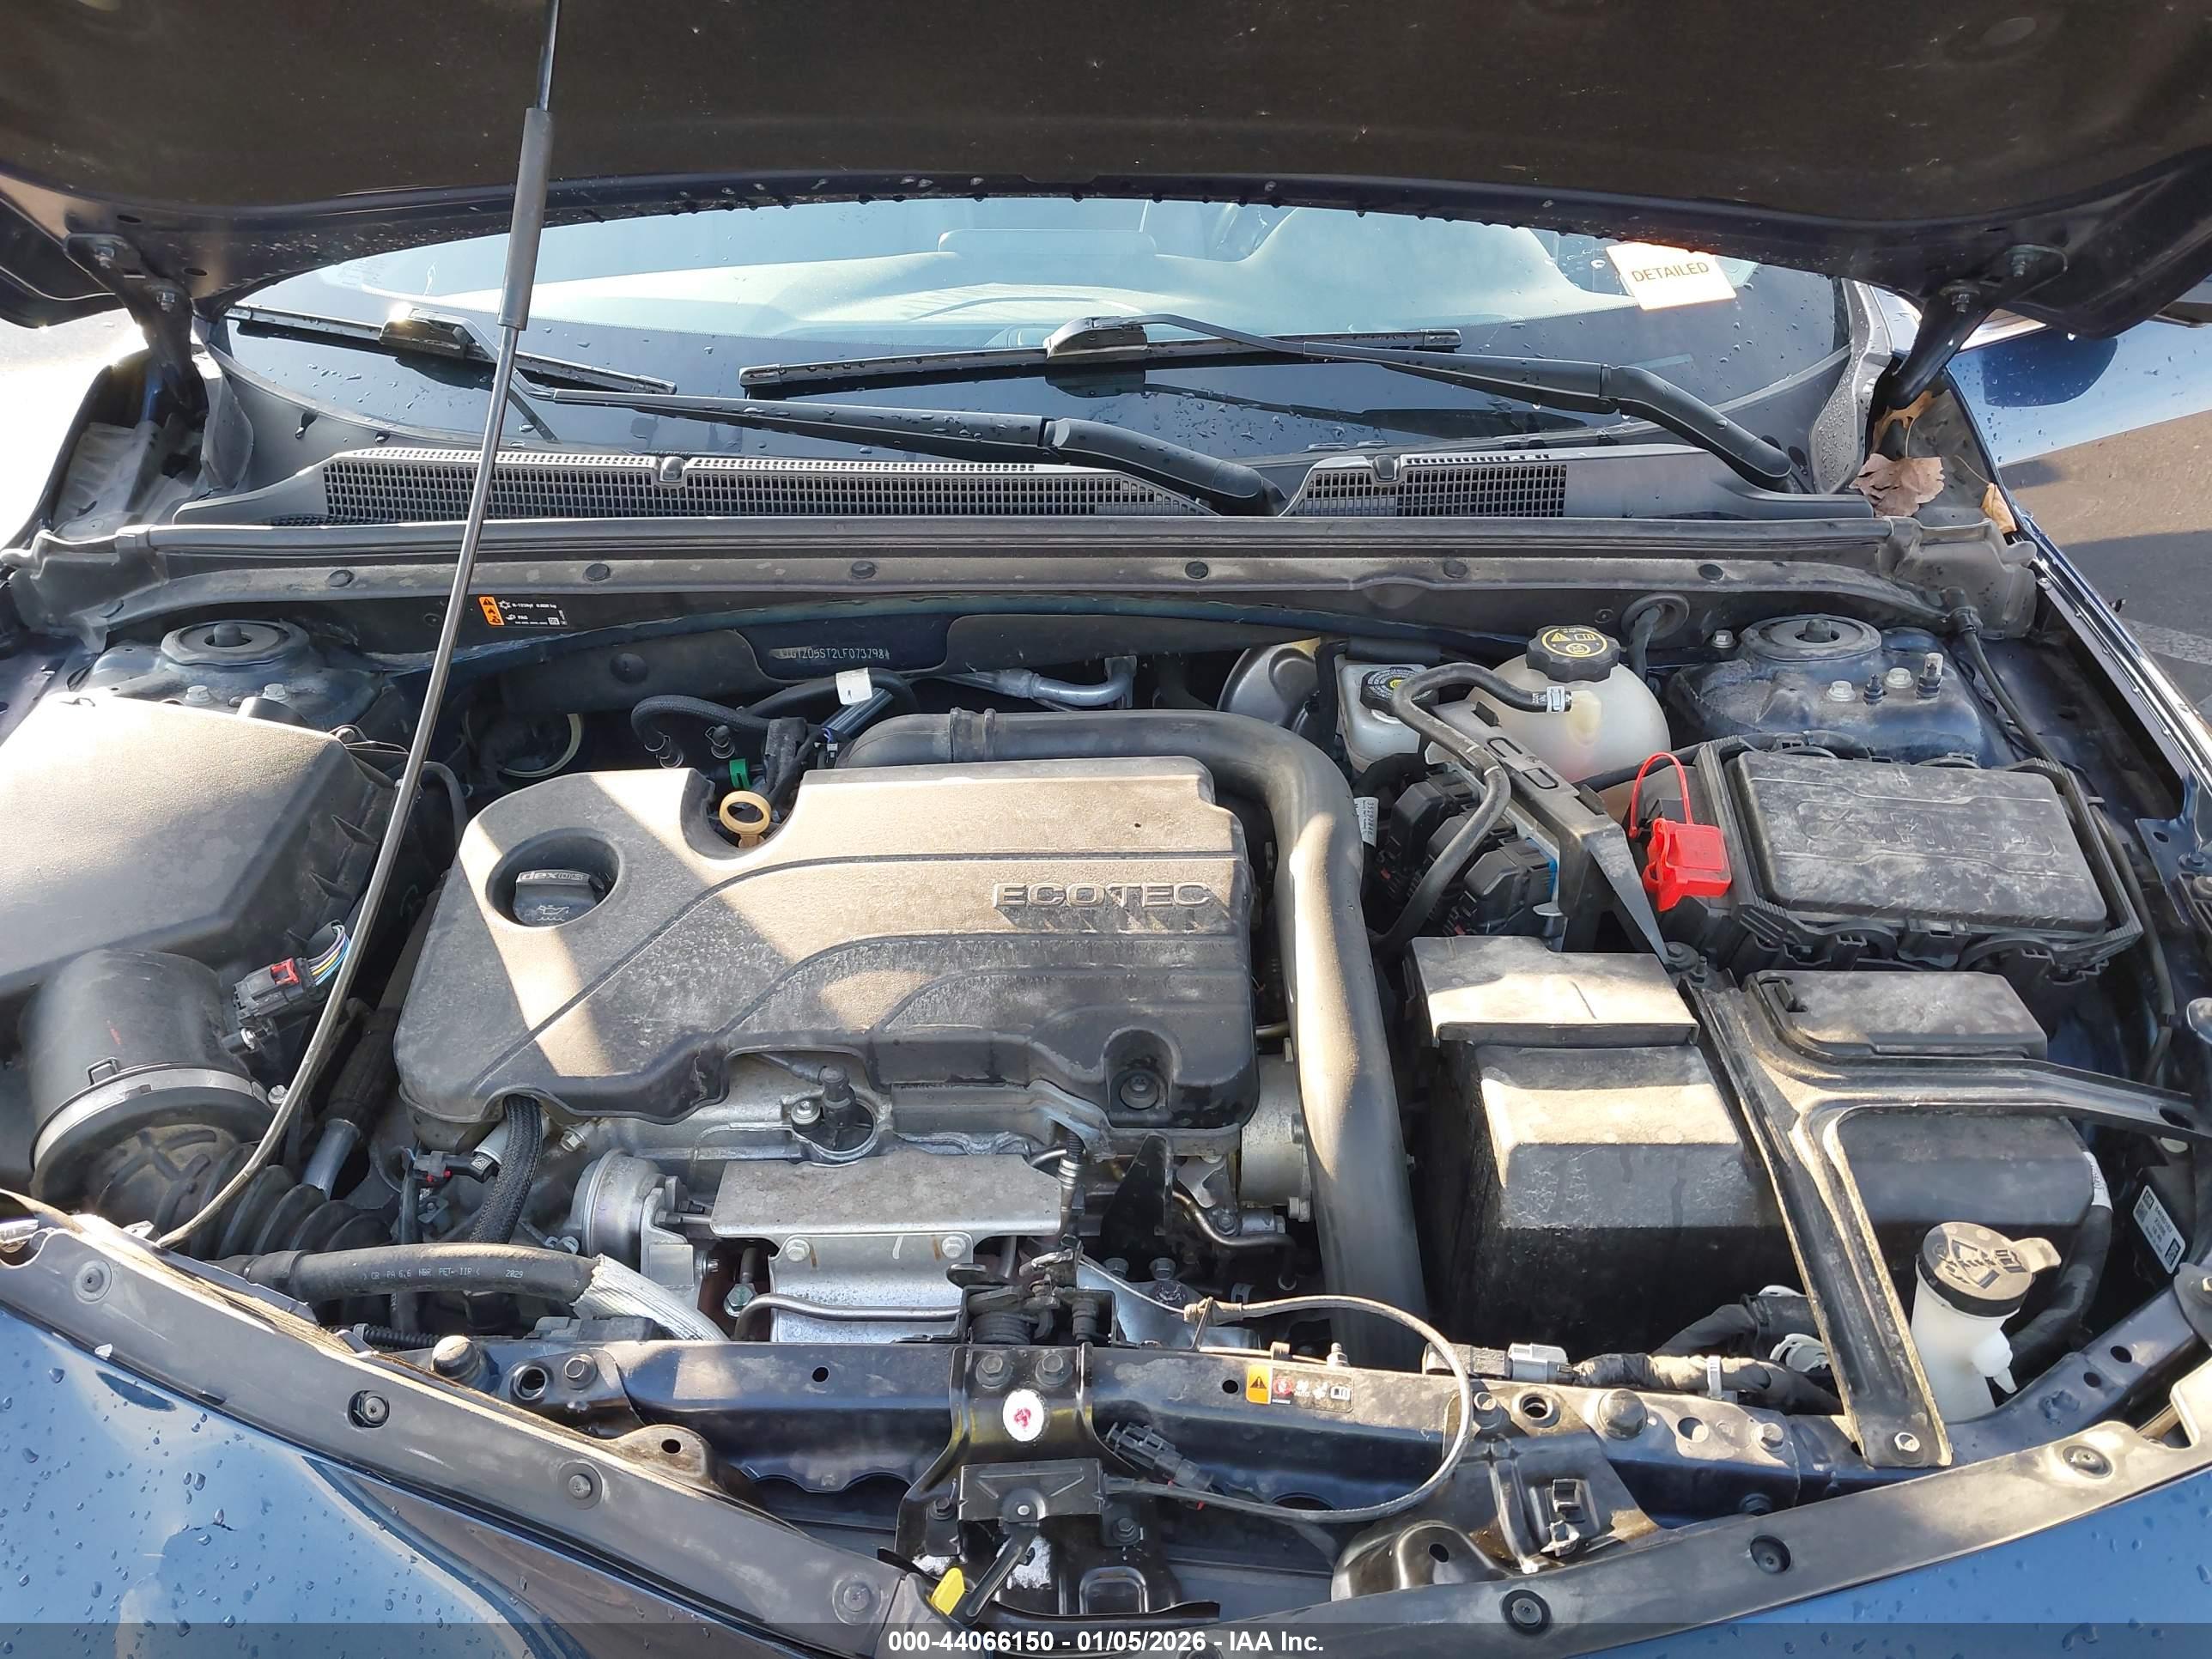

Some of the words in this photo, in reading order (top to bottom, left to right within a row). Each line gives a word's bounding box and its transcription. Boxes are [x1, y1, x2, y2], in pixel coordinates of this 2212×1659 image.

[1632, 262, 1709, 282] DETAILED
[521, 872, 583, 881] dexos
[993, 881, 1212, 908] ECOTEC
